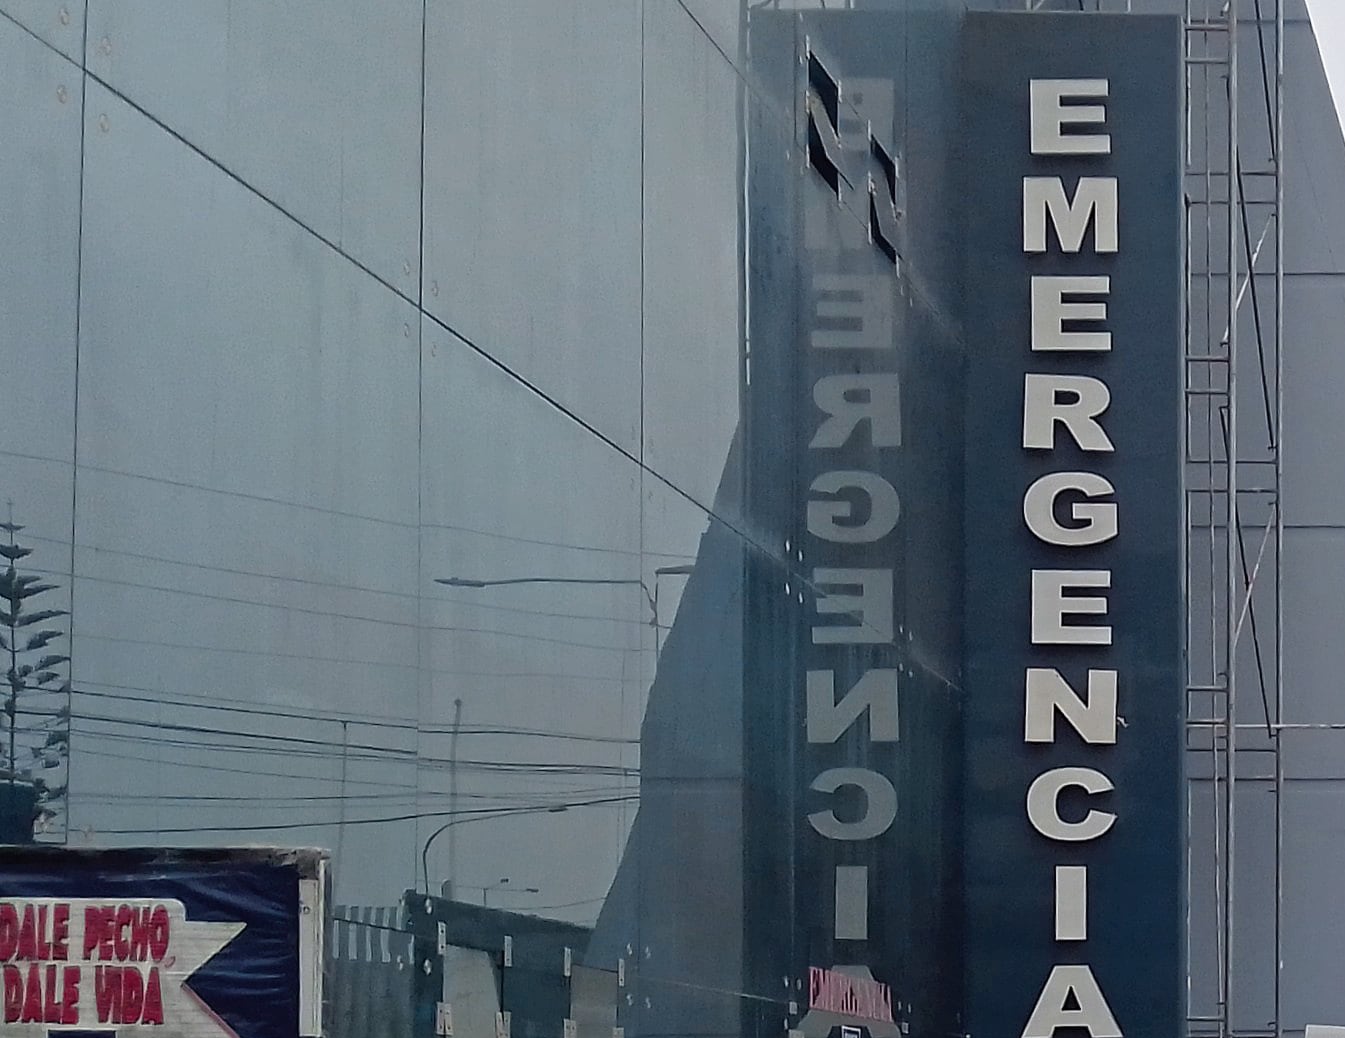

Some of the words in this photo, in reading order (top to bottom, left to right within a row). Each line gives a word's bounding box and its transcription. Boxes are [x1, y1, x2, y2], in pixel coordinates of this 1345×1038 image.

[0, 903, 71, 961] DALE
[3, 963, 81, 1025] DALE
[95, 965, 164, 1025] VIDA
